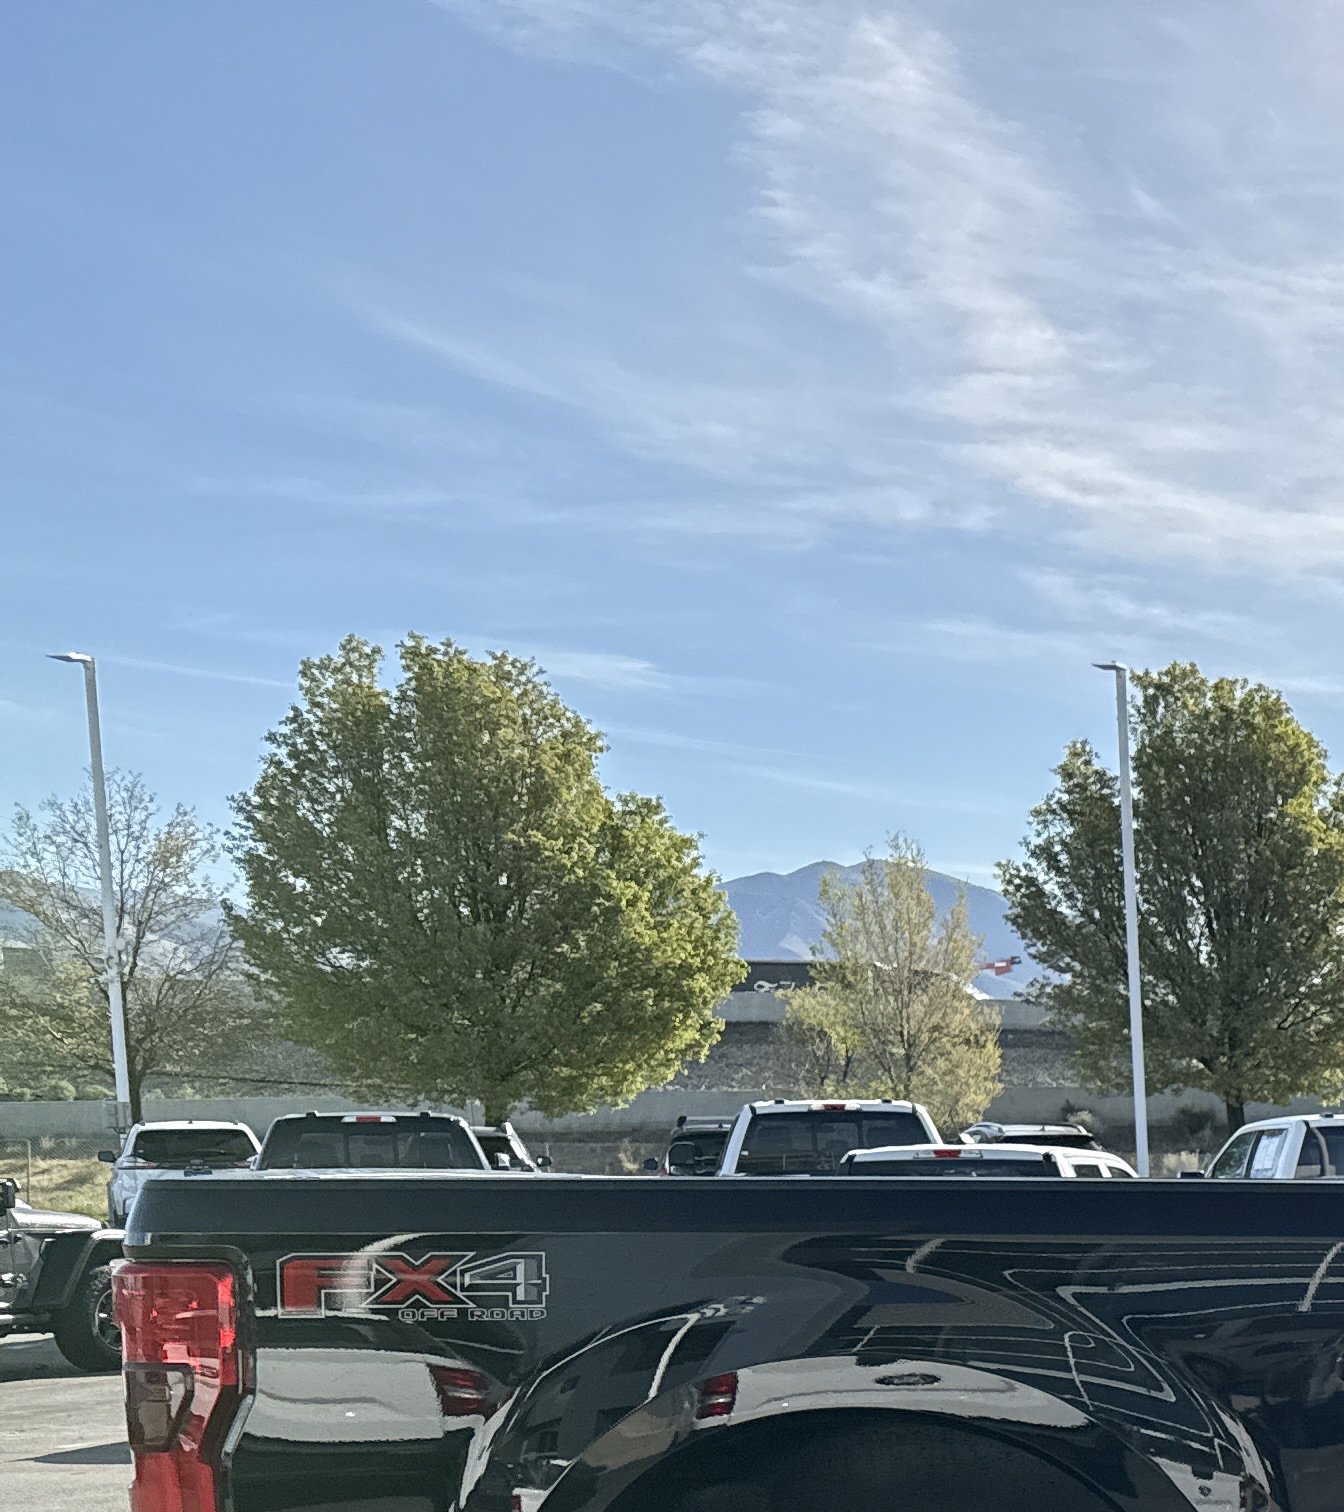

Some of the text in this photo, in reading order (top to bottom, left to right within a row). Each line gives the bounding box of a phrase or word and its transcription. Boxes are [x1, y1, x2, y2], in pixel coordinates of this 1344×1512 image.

[276, 1252, 549, 1318] FX4
[398, 1308, 547, 1321] OFF ROAD
